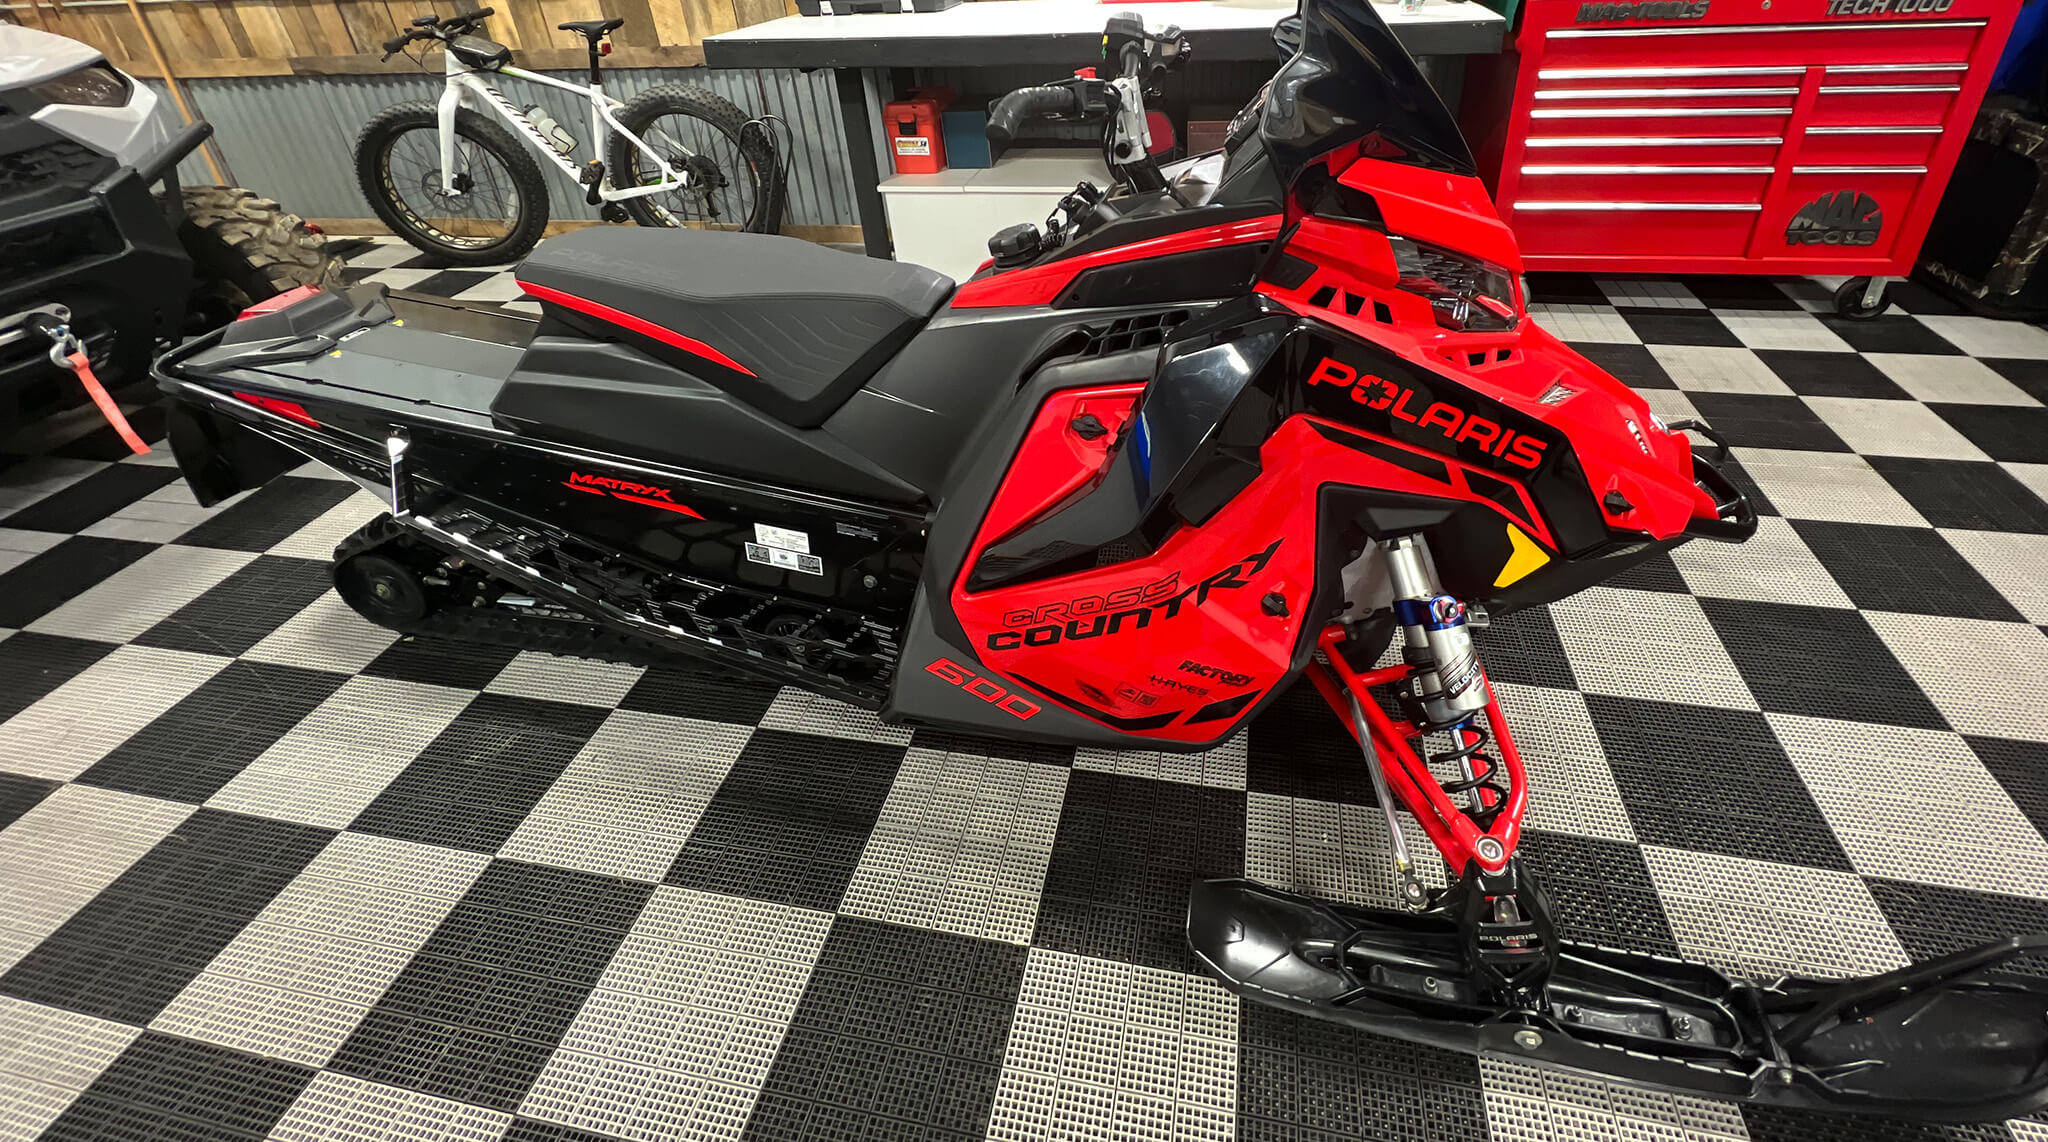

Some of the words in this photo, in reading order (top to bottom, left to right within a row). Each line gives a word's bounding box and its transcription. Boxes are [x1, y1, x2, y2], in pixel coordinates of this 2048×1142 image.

[1826, 0, 1888, 15] TECH
[1894, 0, 1954, 14] 1000
[1785, 189, 1883, 230] MAC
[1786, 230, 1878, 246] TOOLS
[1307, 357, 1548, 470] POLARIS
[569, 471, 675, 502] MATRYX
[986, 537, 1285, 651] COUNTRY
[1002, 570, 1182, 627] CROSS
[924, 657, 1042, 720] 600
[1148, 674, 1209, 697] HAYES
[1178, 660, 1256, 686] FACTORY
